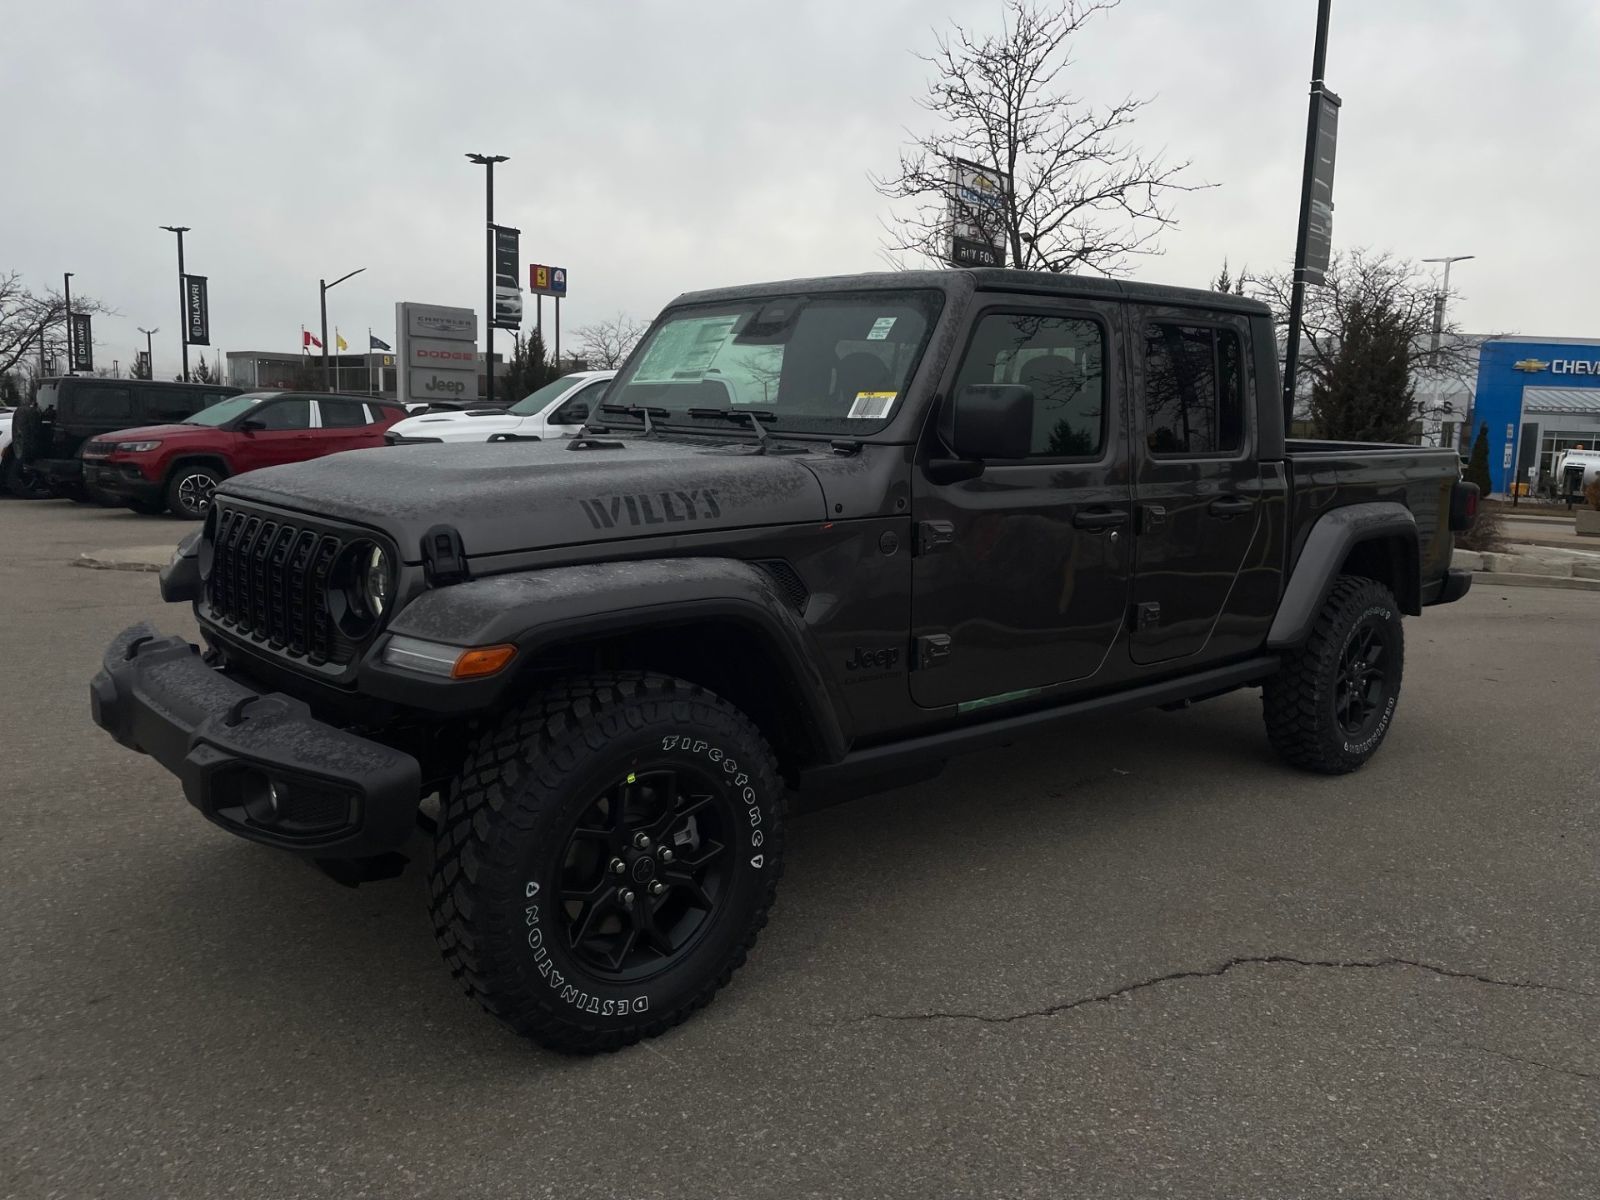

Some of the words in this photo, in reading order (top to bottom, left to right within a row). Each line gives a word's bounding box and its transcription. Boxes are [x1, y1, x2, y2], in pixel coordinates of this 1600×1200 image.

[191, 283, 201, 325] DILAWRI
[417, 316, 472, 327] CHRYSLER
[417, 350, 473, 361] DODGE
[1552, 359, 1600, 375] CHEV
[425, 375, 465, 394] Jeep
[578, 488, 722, 530] WILLYS
[846, 646, 899, 670] Jeep
[662, 735, 764, 848] Firestone
[525, 904, 649, 1016] DESTINATION
